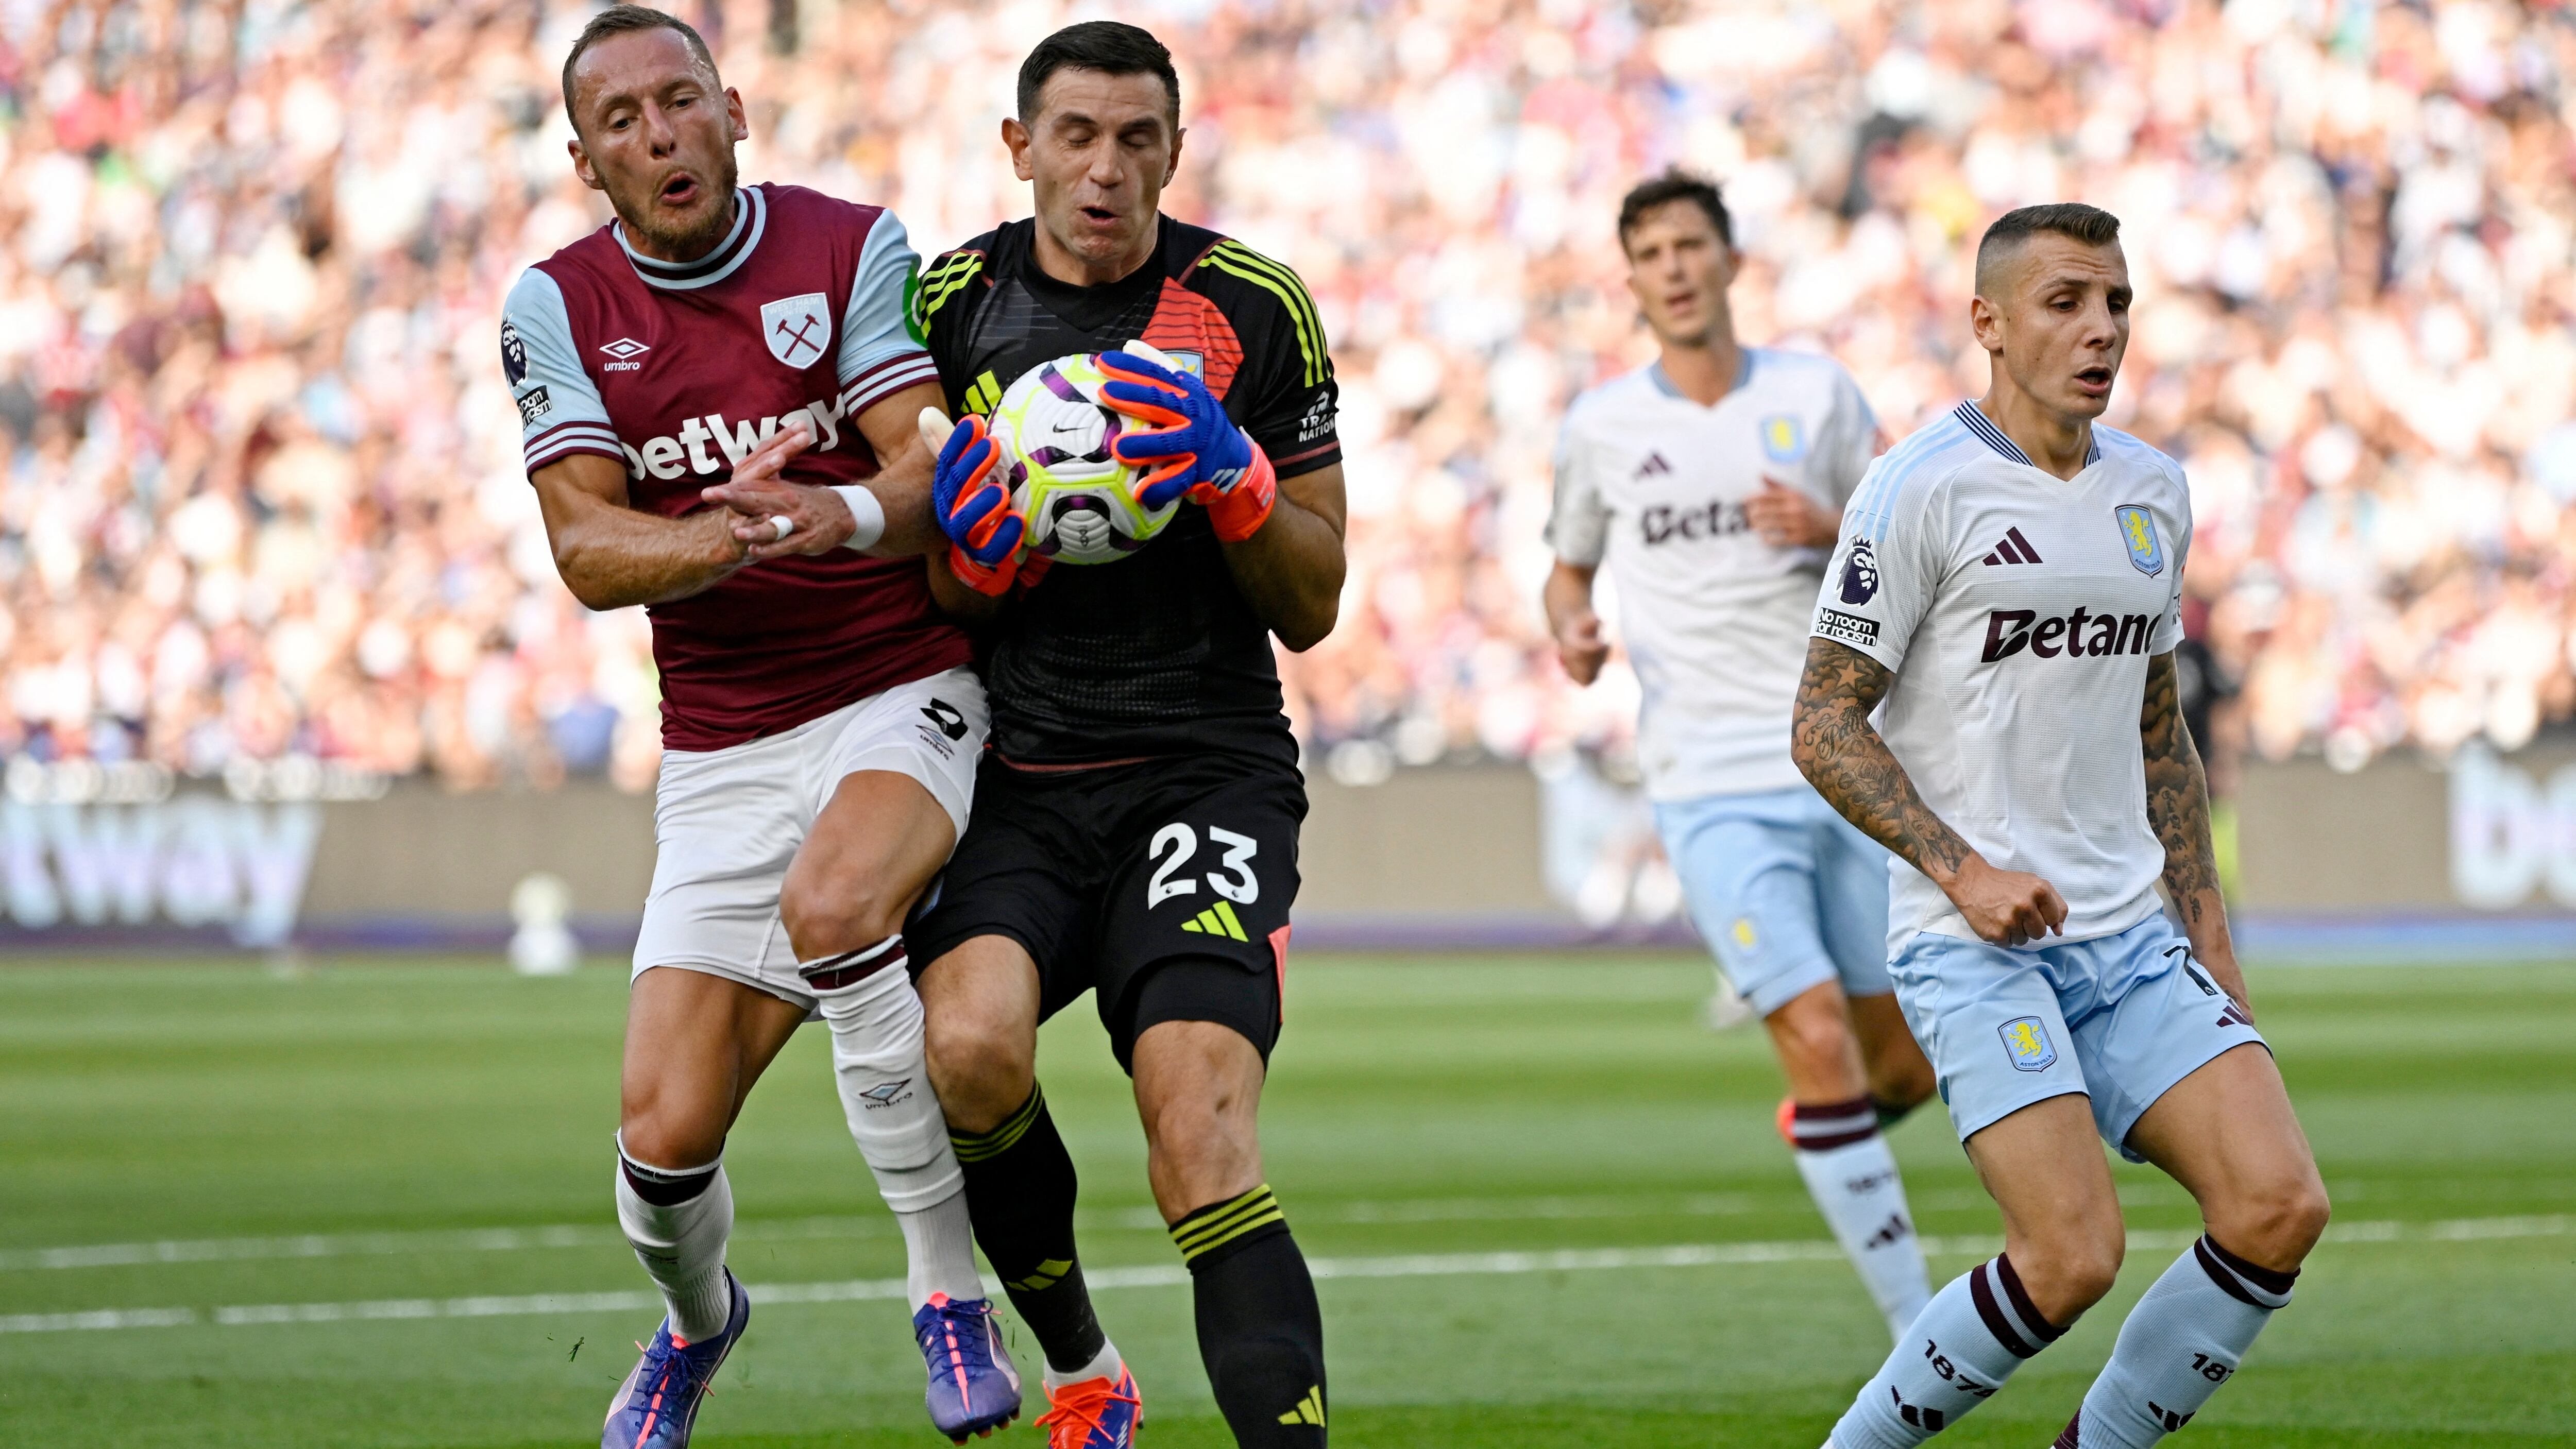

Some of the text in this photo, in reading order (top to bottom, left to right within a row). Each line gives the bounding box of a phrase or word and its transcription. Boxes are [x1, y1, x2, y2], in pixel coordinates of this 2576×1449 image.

[604, 360, 641, 371] umbro
[1299, 417, 1335, 442] NATION
[1816, 619, 1877, 646] for racism
[1818, 607, 1873, 634] No room
[920, 734, 950, 761] umbro
[1147, 822, 1259, 911] 23
[2039, 1054, 2053, 1065] VILLA
